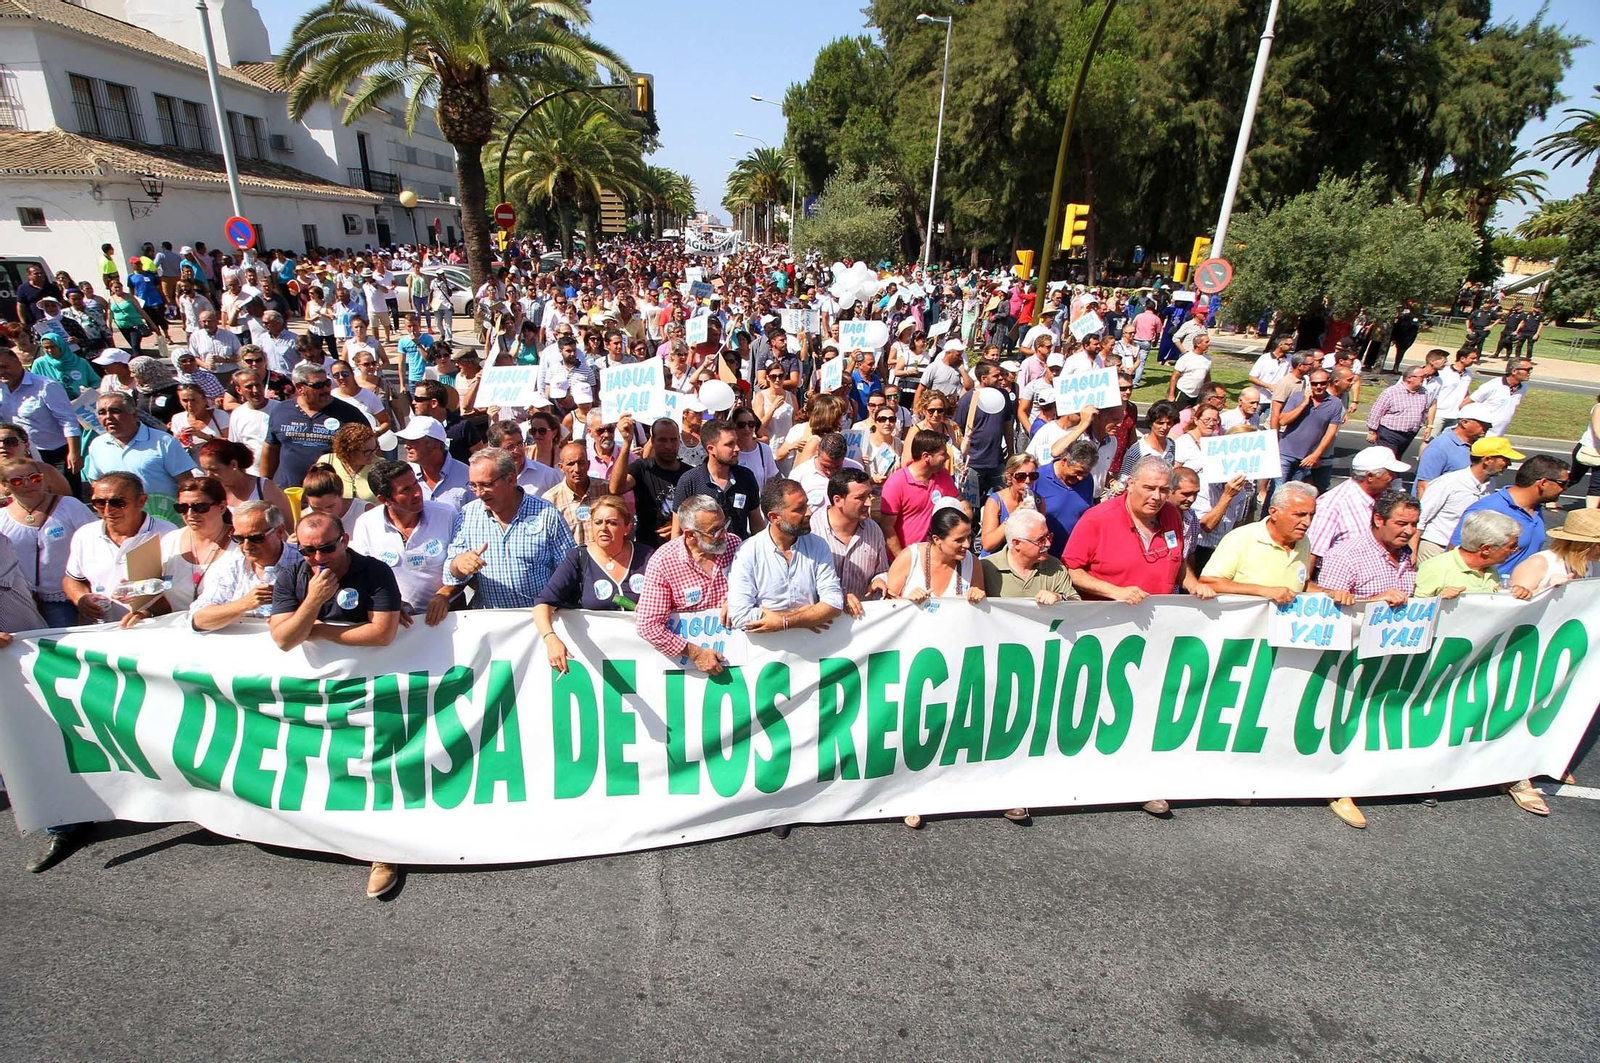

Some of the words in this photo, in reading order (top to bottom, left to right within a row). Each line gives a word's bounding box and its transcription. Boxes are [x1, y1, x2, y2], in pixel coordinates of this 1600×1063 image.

[485, 369, 531, 384] ¡¡AGUA
[606, 366, 655, 392] ¡¡AGUA
[1060, 372, 1110, 394] ¡¡AGUA
[491, 387, 521, 402] YA!!
[616, 391, 650, 414] YA!!
[1073, 391, 1105, 410] YA!!
[1207, 435, 1266, 456] ¡¡AGUA
[1221, 455, 1261, 475] YA!!
[1290, 621, 1335, 647] YA!!
[1379, 626, 1424, 648] YA!!
[33, 638, 162, 780] EN
[173, 659, 527, 811] DEFENSA
[551, 659, 639, 799] DE
[663, 661, 791, 798] LOS
[816, 618, 1146, 783] REGADÍOS
[1151, 636, 1279, 755] DEL
[1294, 618, 1588, 756] CONDADO
